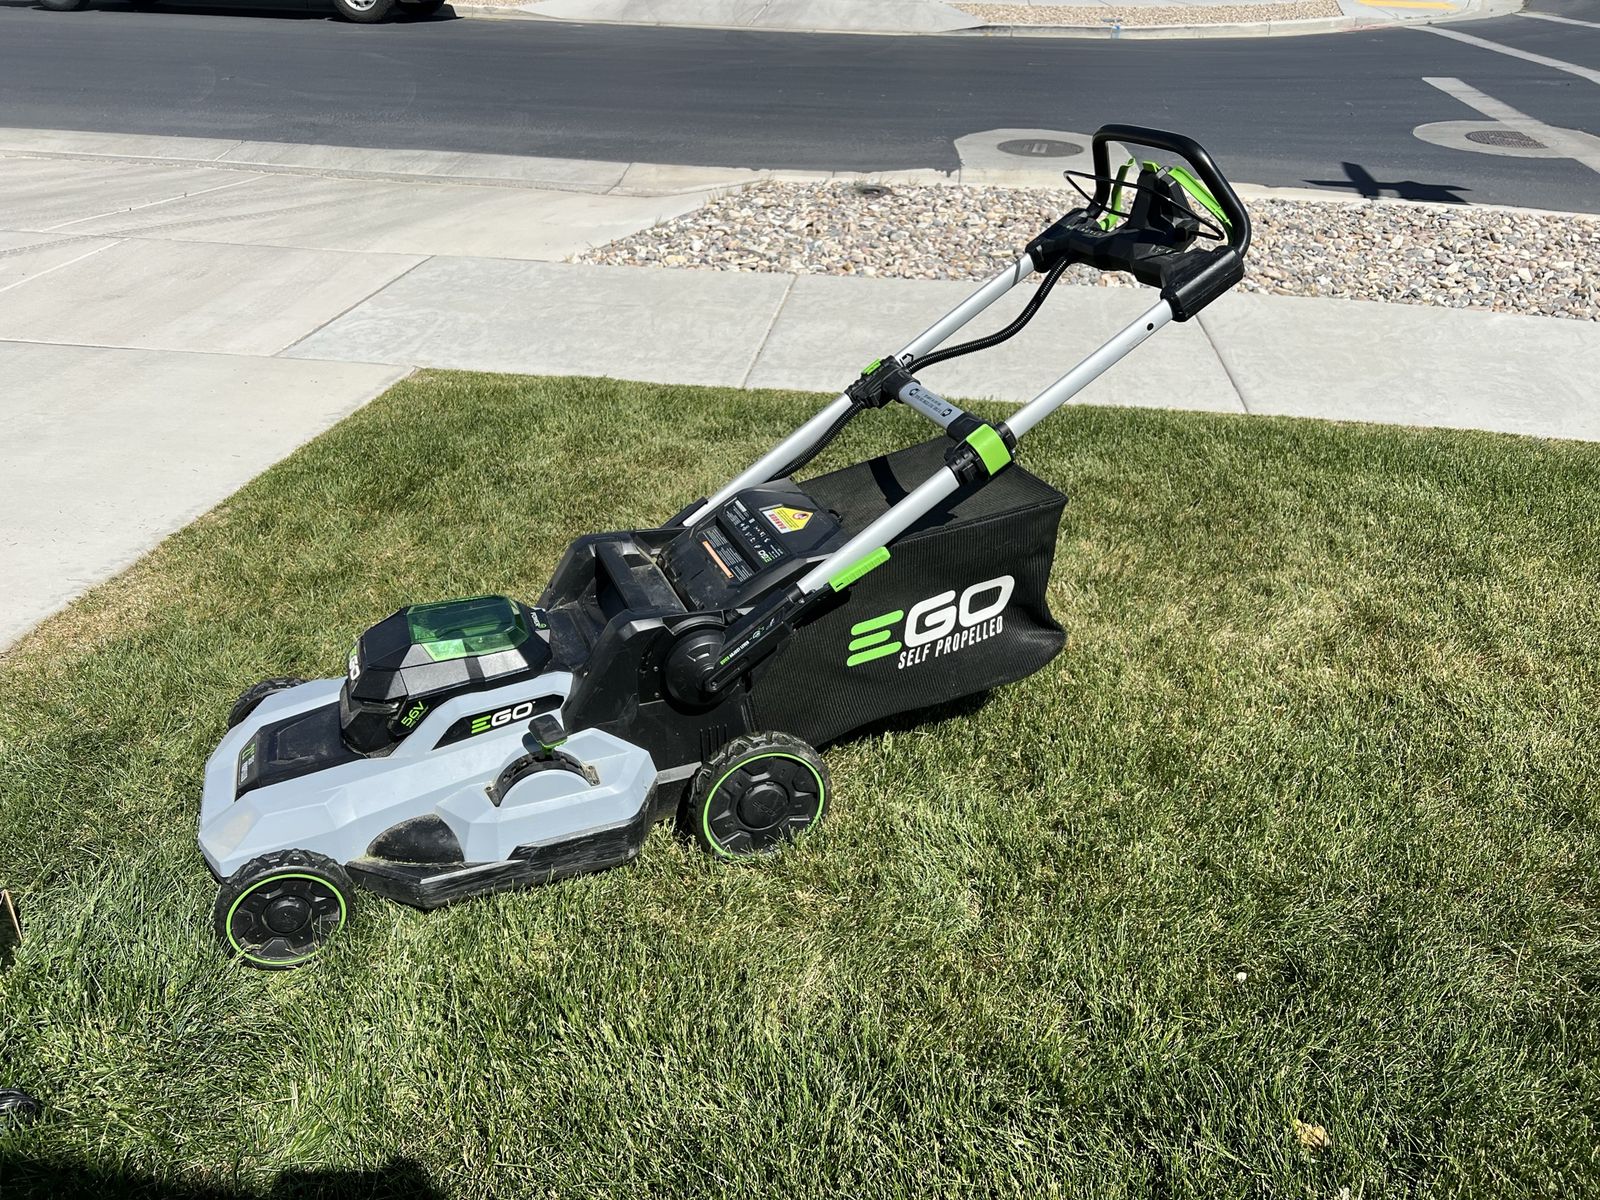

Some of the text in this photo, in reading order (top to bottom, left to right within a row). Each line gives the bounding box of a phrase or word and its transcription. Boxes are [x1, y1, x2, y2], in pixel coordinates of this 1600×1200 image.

[847, 575, 1016, 667] EGO
[898, 616, 1003, 670] SELF PROPELLED
[400, 700, 425, 727] 56V
[471, 702, 533, 734] EGO
